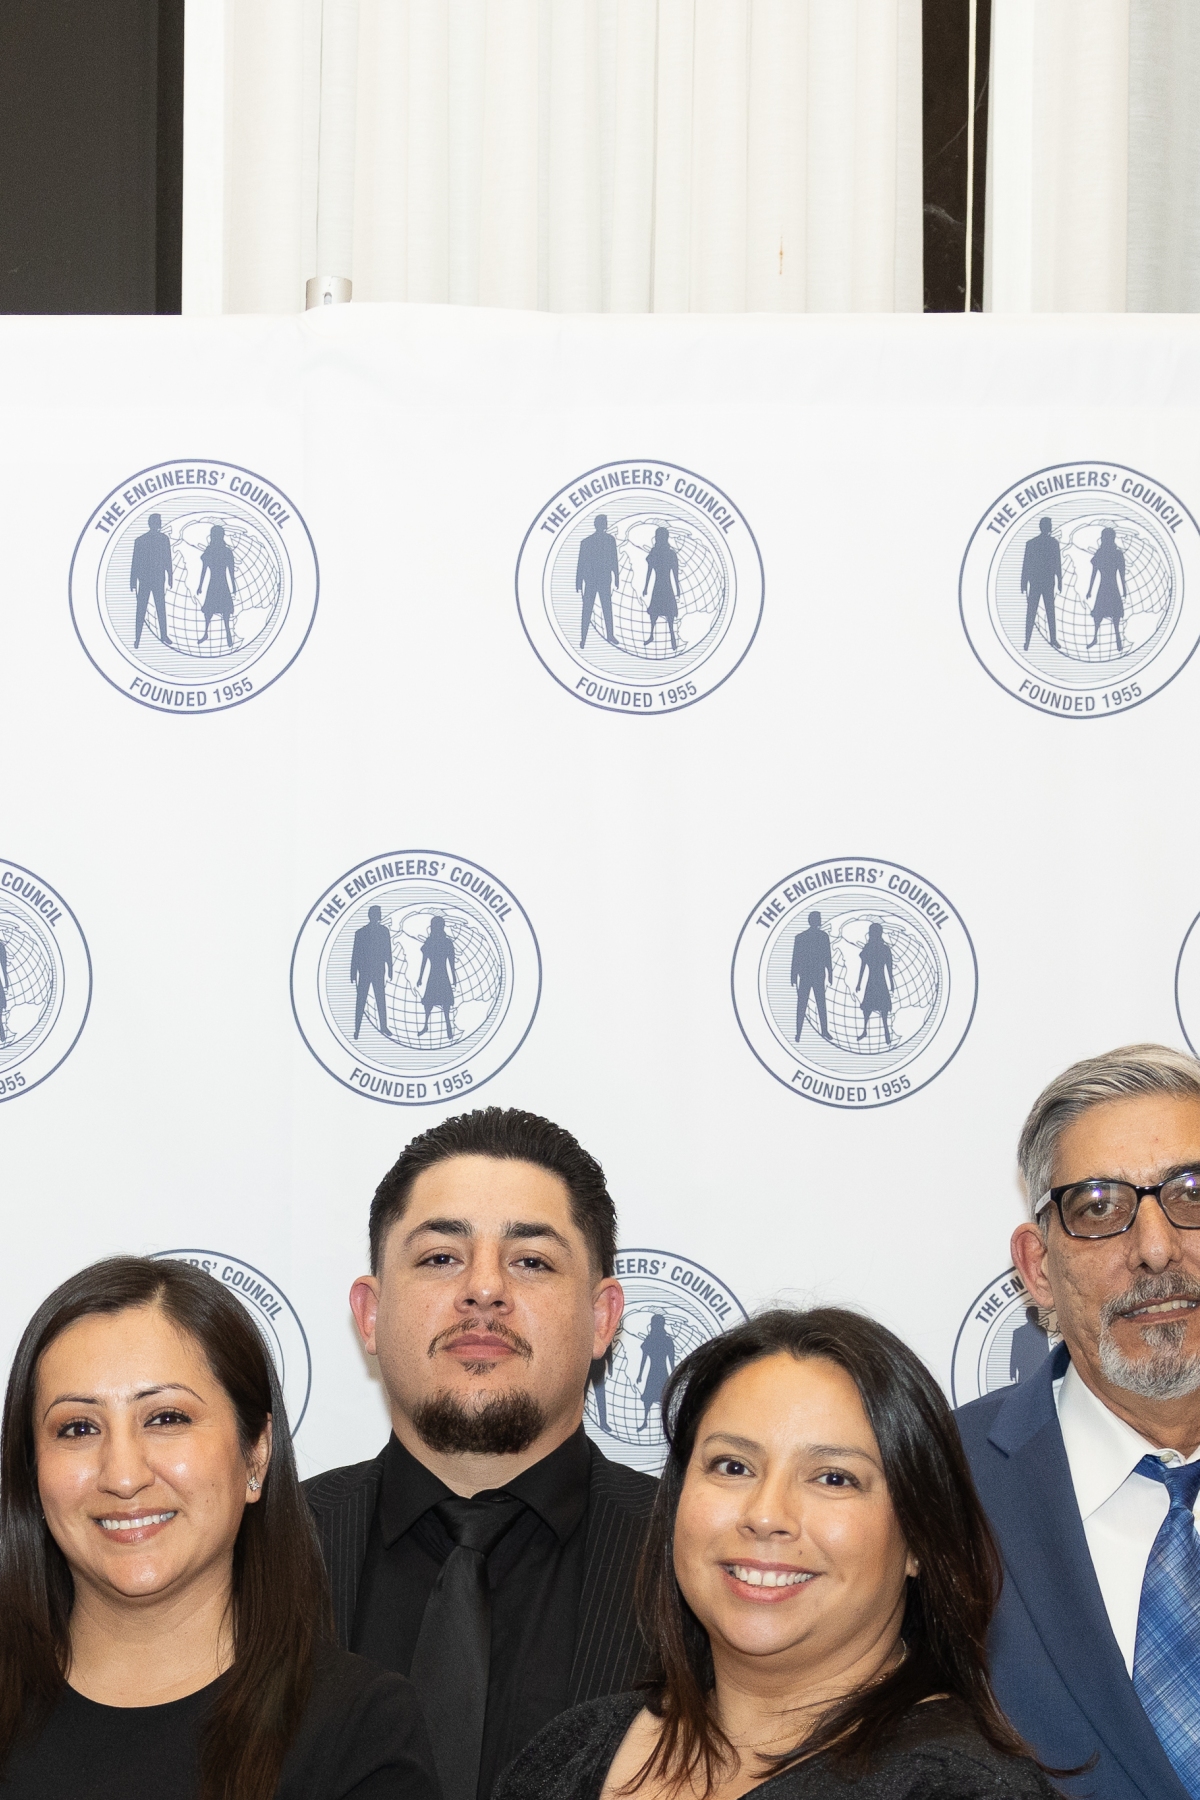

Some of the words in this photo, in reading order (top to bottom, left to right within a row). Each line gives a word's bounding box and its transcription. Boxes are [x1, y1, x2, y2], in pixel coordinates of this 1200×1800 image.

[95, 502, 126, 535] THE
[122, 467, 226, 508] ENGINEERS'
[228, 475, 290, 531] COUNCIL
[541, 502, 572, 534] THE
[568, 469, 670, 508] ENGINEERS'
[673, 478, 735, 535] COUNCIL
[985, 505, 1017, 537] THE
[1013, 469, 1118, 511] ENGINEERS'
[1120, 478, 1183, 534] COUNCIL
[129, 675, 208, 707] FOUNDED
[213, 676, 253, 704] 1955
[575, 675, 653, 709] FOUNDED
[658, 680, 698, 706] 1955
[1017, 679, 1097, 712] FOUNDED
[1102, 681, 1143, 709] 1955
[1, 872, 62, 927] COUNCIL
[315, 894, 346, 926] THE
[342, 858, 446, 899] ENGINEERS'
[449, 867, 512, 922] COUNCIL
[756, 898, 786, 930] THE
[783, 865, 884, 904] ENGINEERS'
[887, 875, 948, 930] COUNCIL
[348, 1067, 428, 1099] FOUNDED
[433, 1068, 474, 1096] 1955
[790, 1070, 868, 1103] FOUNDED
[872, 1074, 912, 1100] 1955
[221, 1266, 282, 1321] COUNCIL
[615, 1257, 667, 1276] EERS'
[670, 1266, 732, 1321] COUNCIL
[974, 1293, 1004, 1324] THE
